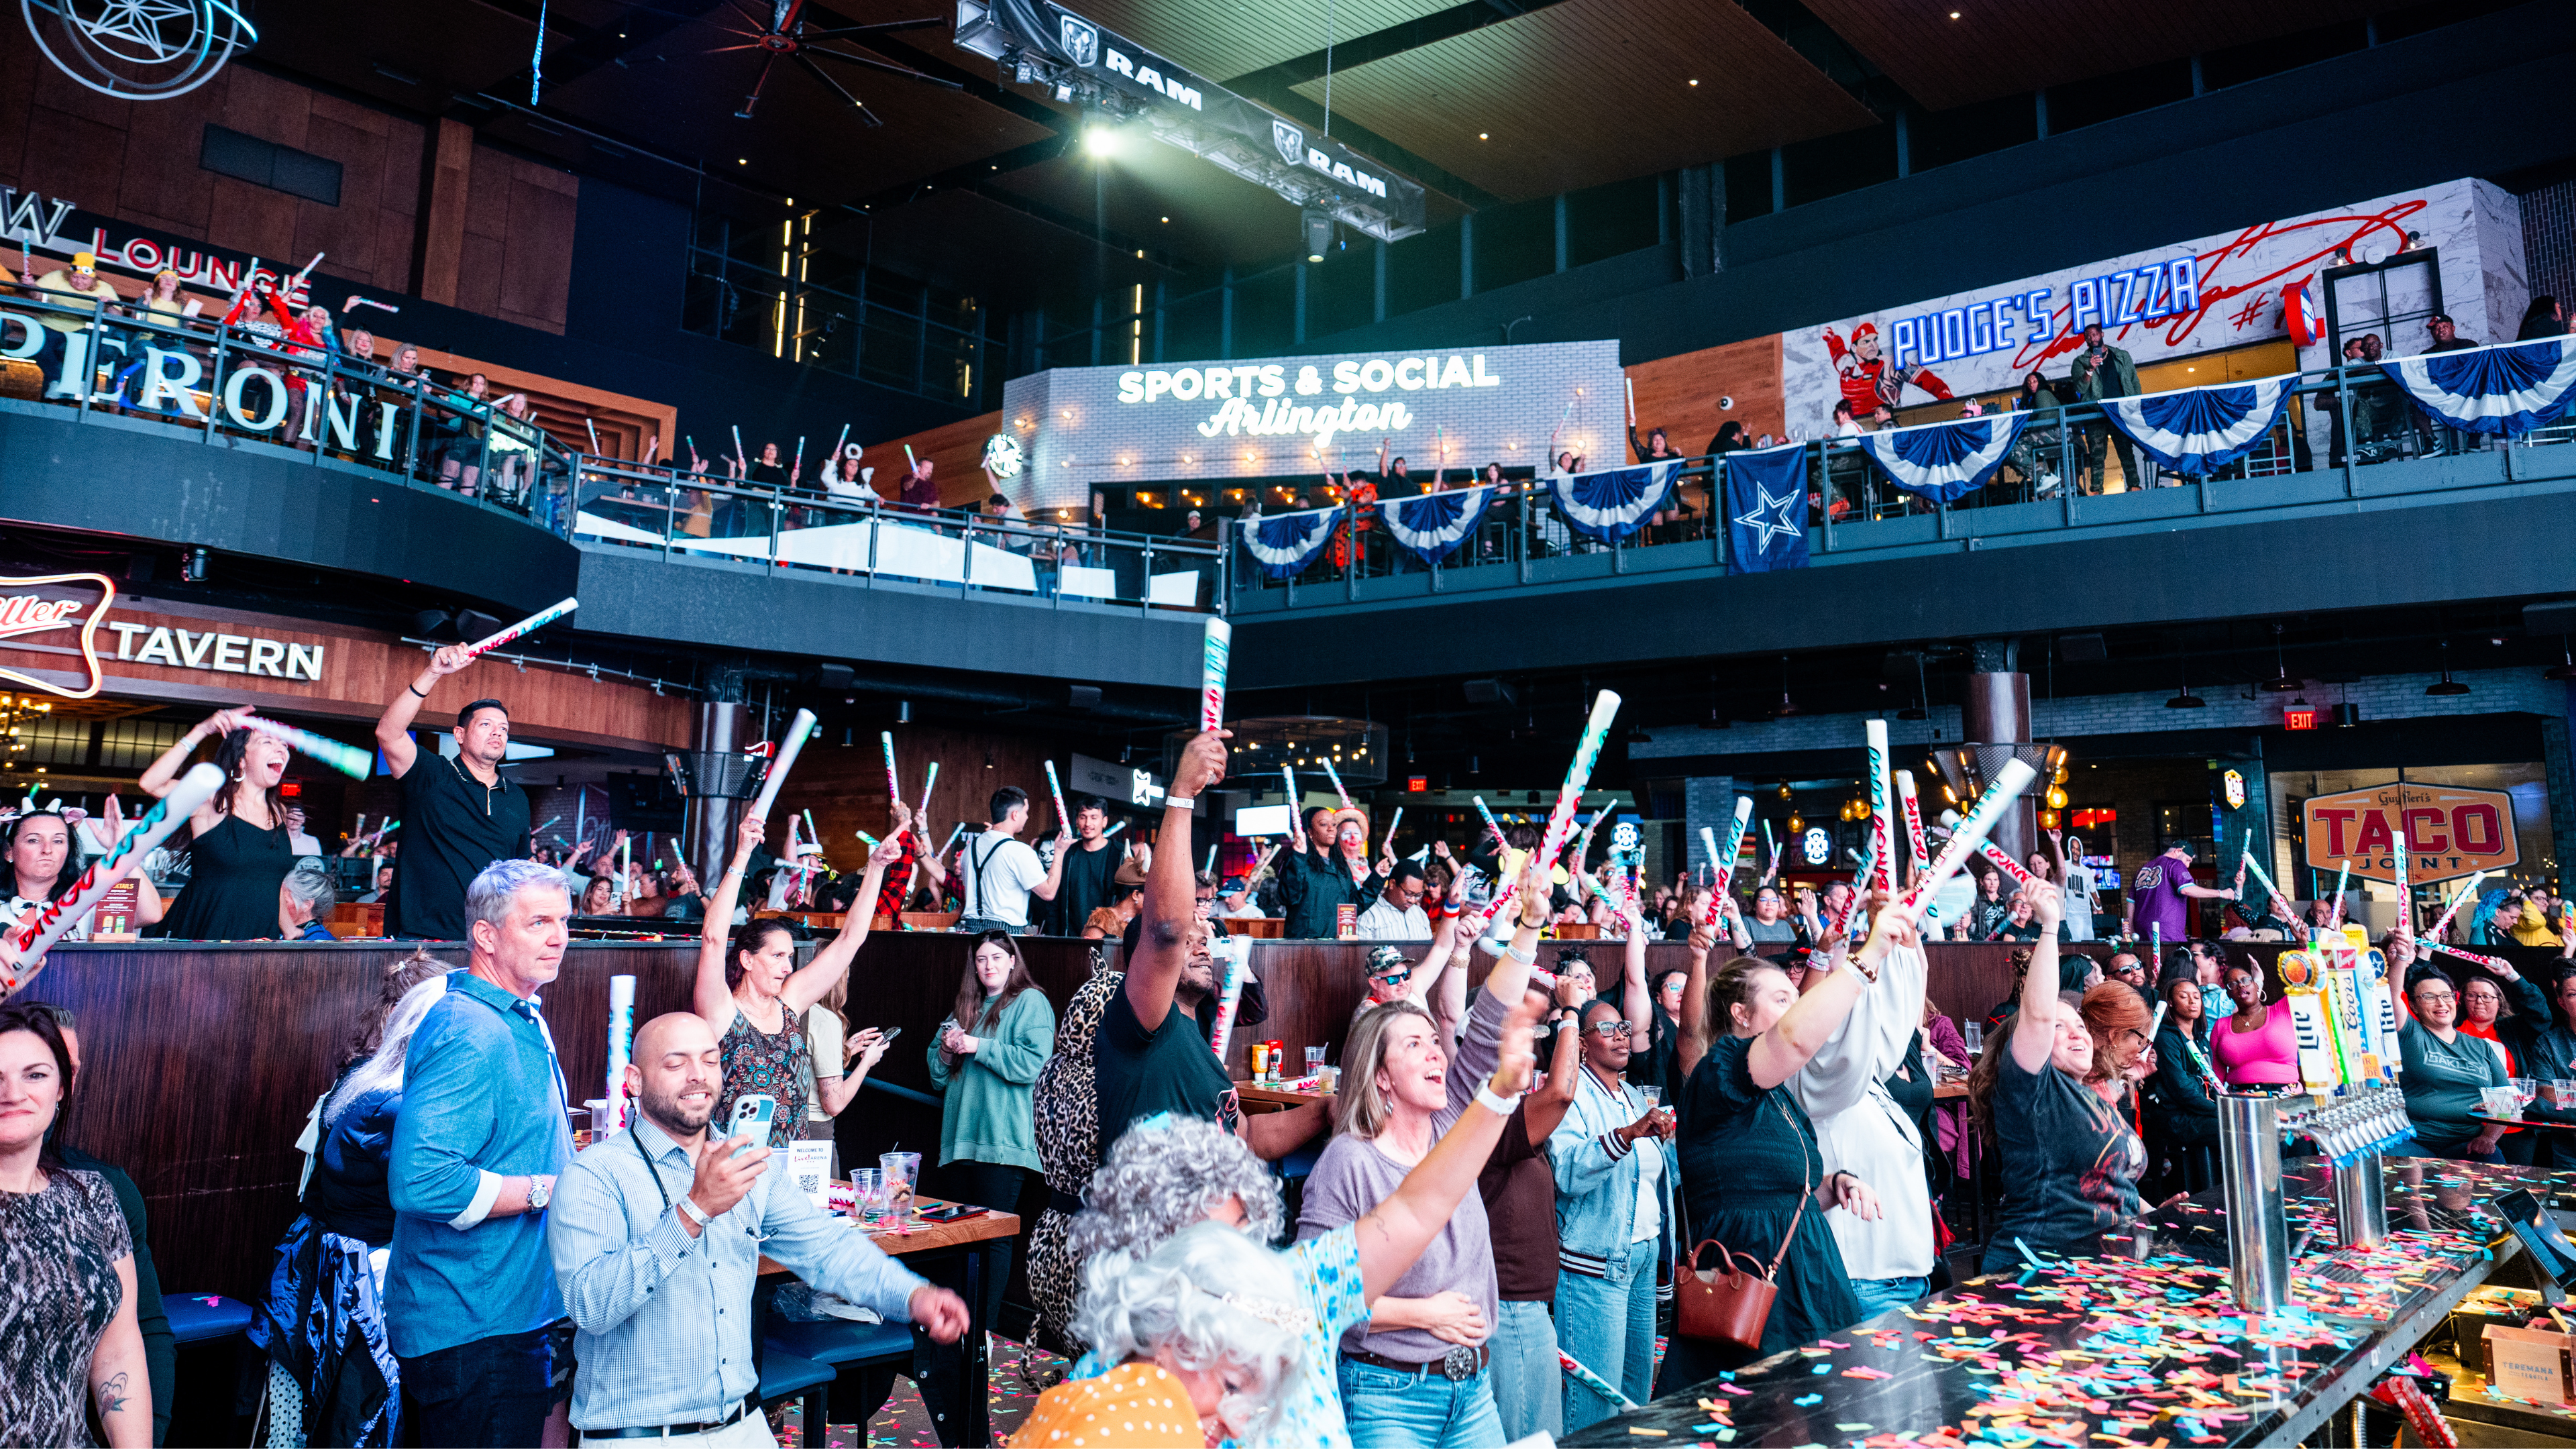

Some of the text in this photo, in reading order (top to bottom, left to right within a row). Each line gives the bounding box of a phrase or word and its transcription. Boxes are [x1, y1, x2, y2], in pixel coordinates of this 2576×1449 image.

[1106, 48, 1203, 111] RAM
[1308, 147, 1387, 198] RAM
[92, 227, 312, 310] LOUNGE
[1892, 288, 2054, 370] PUDGE'S
[2070, 256, 2200, 335] PIZZA
[1117, 354, 1501, 404] SPORTS & SOCIAL
[1197, 395, 1413, 448] Arlington
[109, 621, 325, 681] TAVERN
[2291, 714, 2312, 729] EXIT
[1412, 780, 1424, 790] EXIT
[2313, 803, 2505, 859] TACO
[1705, 816, 1743, 926] BINGO LOCO
[2135, 865, 2163, 891] 23
[2343, 976, 2358, 1031] Coors
[2381, 999, 2396, 1034] Lite
[2294, 1011, 2320, 1051] Lite
[2428, 1053, 2487, 1077] OAKLEY
[794, 1154, 810, 1163] Live!
[2502, 1362, 2553, 1375] TEREMANA
